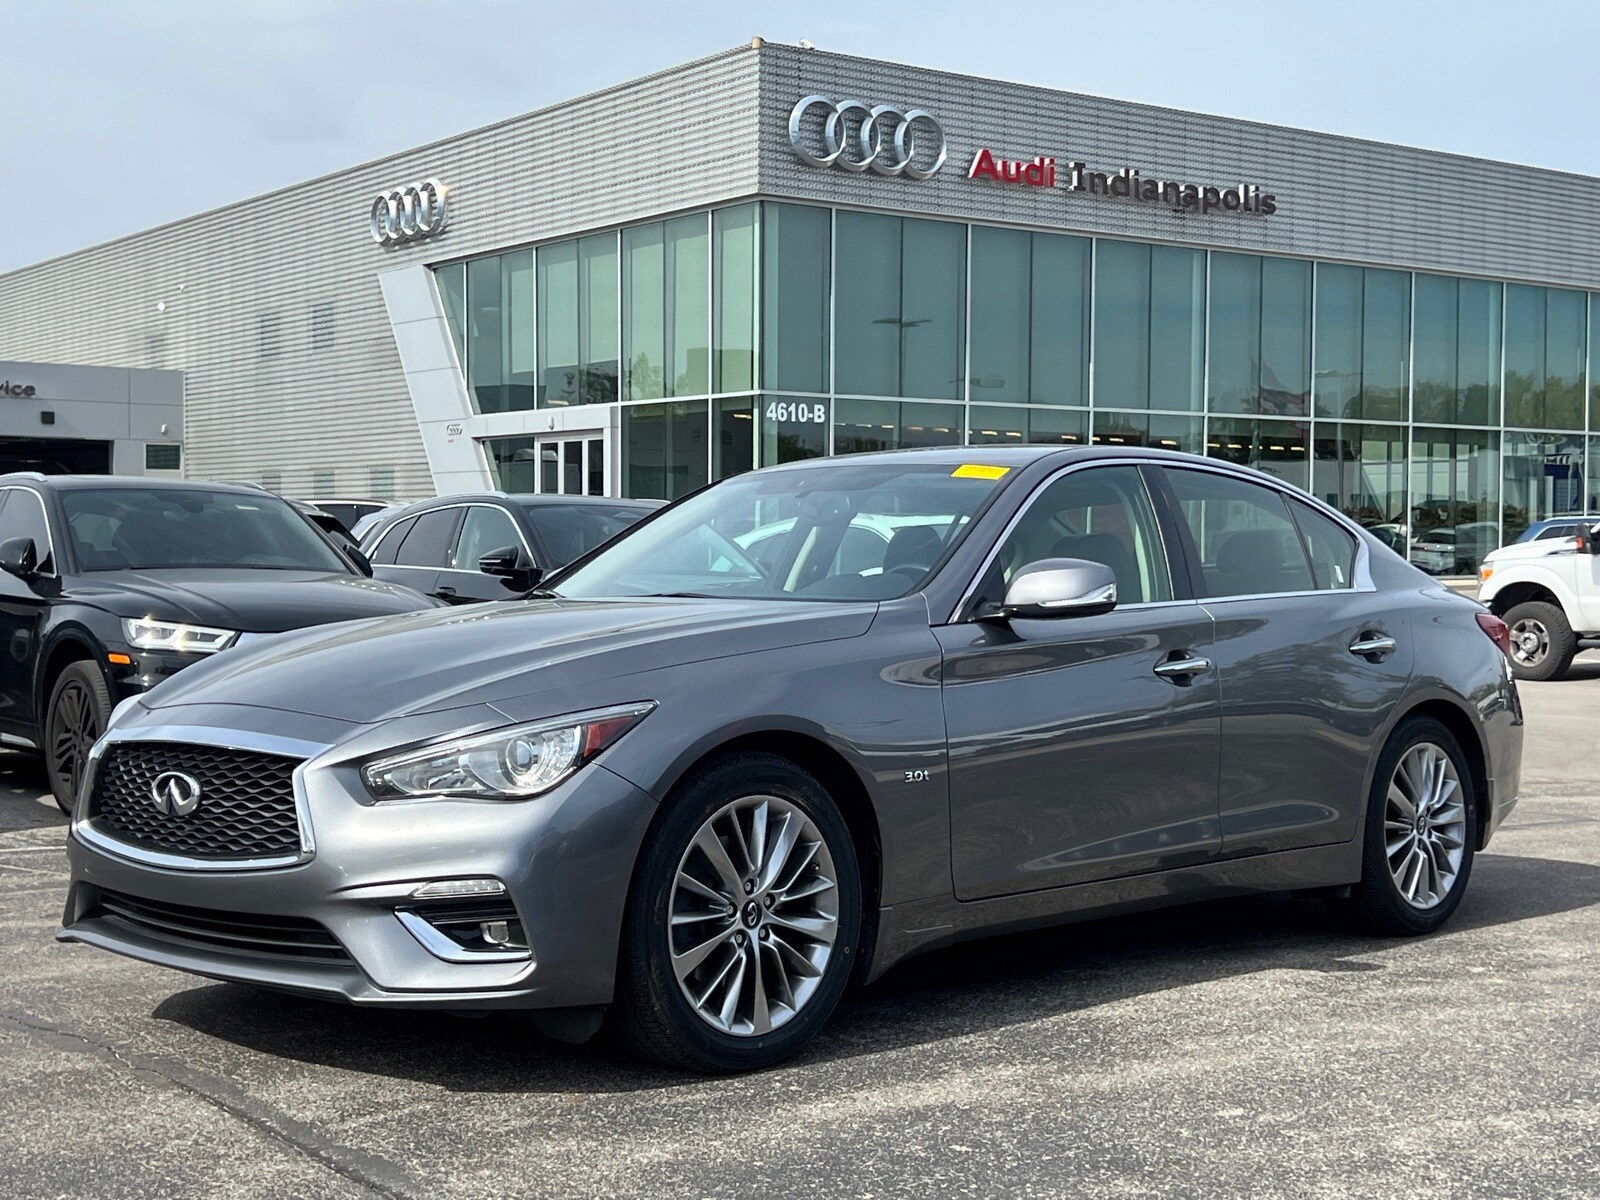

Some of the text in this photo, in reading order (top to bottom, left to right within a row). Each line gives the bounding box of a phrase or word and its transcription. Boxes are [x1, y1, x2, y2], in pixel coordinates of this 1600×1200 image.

[969, 149, 1277, 215] Audi Indianapolis
[766, 401, 825, 423] 4610-B
